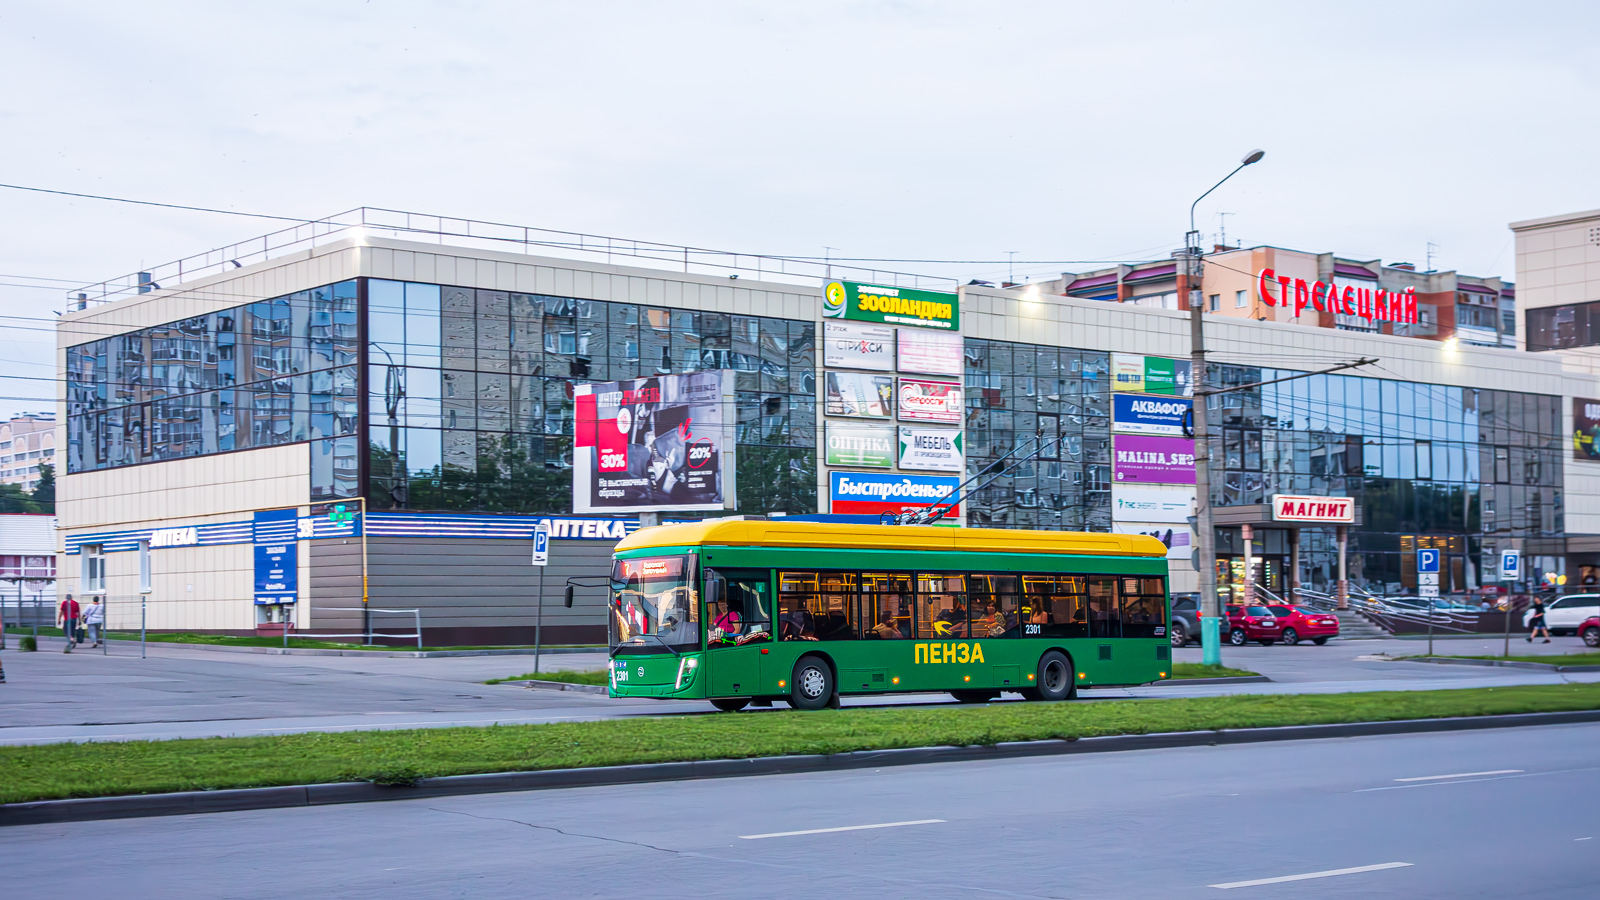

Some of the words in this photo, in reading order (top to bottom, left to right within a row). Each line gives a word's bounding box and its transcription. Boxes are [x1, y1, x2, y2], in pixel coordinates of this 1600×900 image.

[858, 294, 952, 320] ЗООЛАНДИЯ
[1131, 400, 1187, 415] АКВАФОР
[829, 435, 892, 452] ОПТИКА
[914, 435, 951, 450] МЕБЕЛЬ
[689, 446, 712, 459] 20%
[601, 454, 625, 468] 30%
[838, 477, 954, 500] Быстроденьги
[1281, 501, 1347, 517] МАГНИТ
[540, 519, 627, 538] АПТЕКА
[149, 527, 198, 547] АПТЕКА
[1422, 552, 1434, 570] P
[1506, 556, 1515, 569] P
[1025, 624, 1041, 635] 2301
[914, 643, 985, 664] ПЕНЗА
[616, 671, 628, 681] 2301
